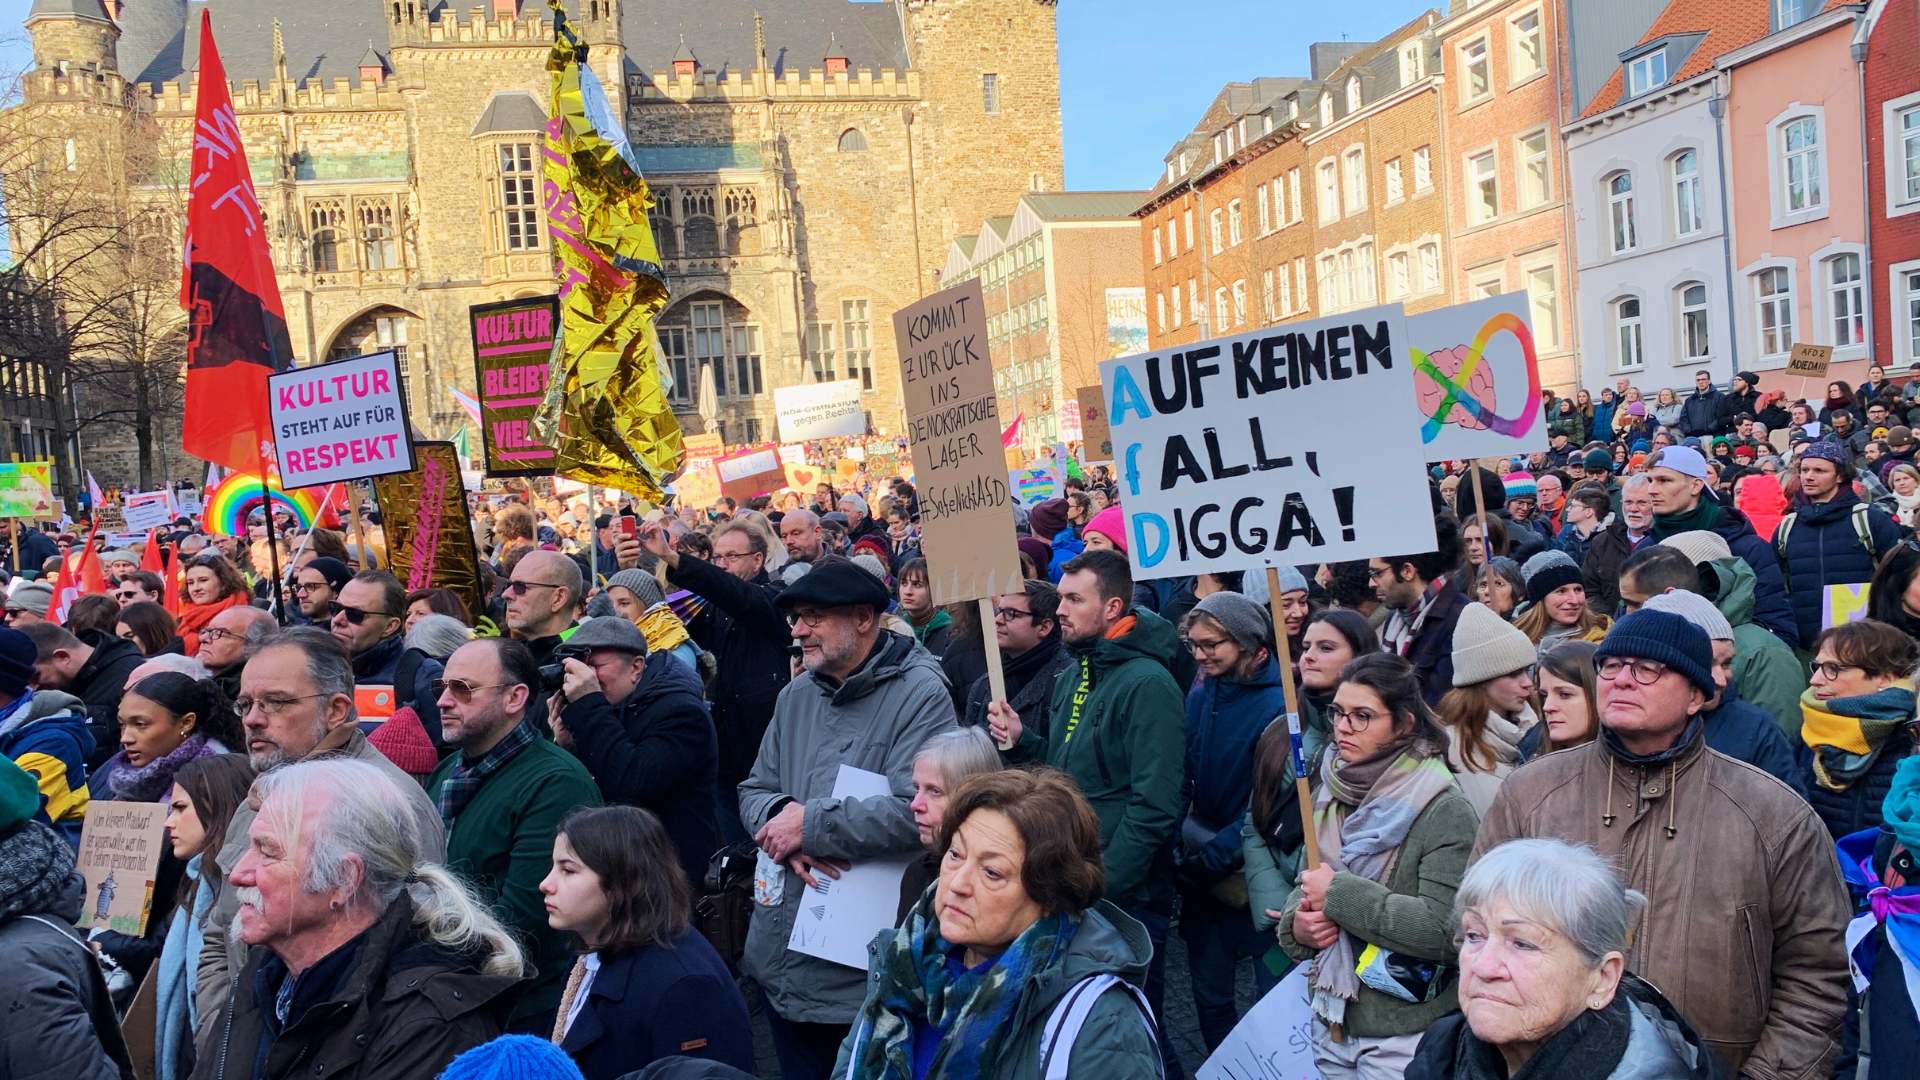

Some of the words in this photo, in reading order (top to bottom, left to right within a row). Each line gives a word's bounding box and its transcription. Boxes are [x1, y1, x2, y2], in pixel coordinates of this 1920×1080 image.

[475, 308, 553, 345] KULTUR
[907, 296, 970, 349] KOMMT
[904, 334, 980, 383] ZURÜCK
[1110, 345, 1221, 426] AUF
[1232, 320, 1393, 399] KEINEN
[278, 368, 392, 412] KULTUR
[484, 363, 549, 397] BLEIBT
[930, 376, 960, 407] INS
[281, 416, 329, 439] STEHT
[333, 412, 361, 431] AUF
[364, 404, 396, 424] FÜR
[793, 414, 823, 428] gegen
[908, 396, 996, 447] DEMOKRATISCHE
[285, 433, 399, 475] RESPEKT
[927, 432, 984, 471] LAGER
[1131, 485, 1356, 569] DIGGA!
